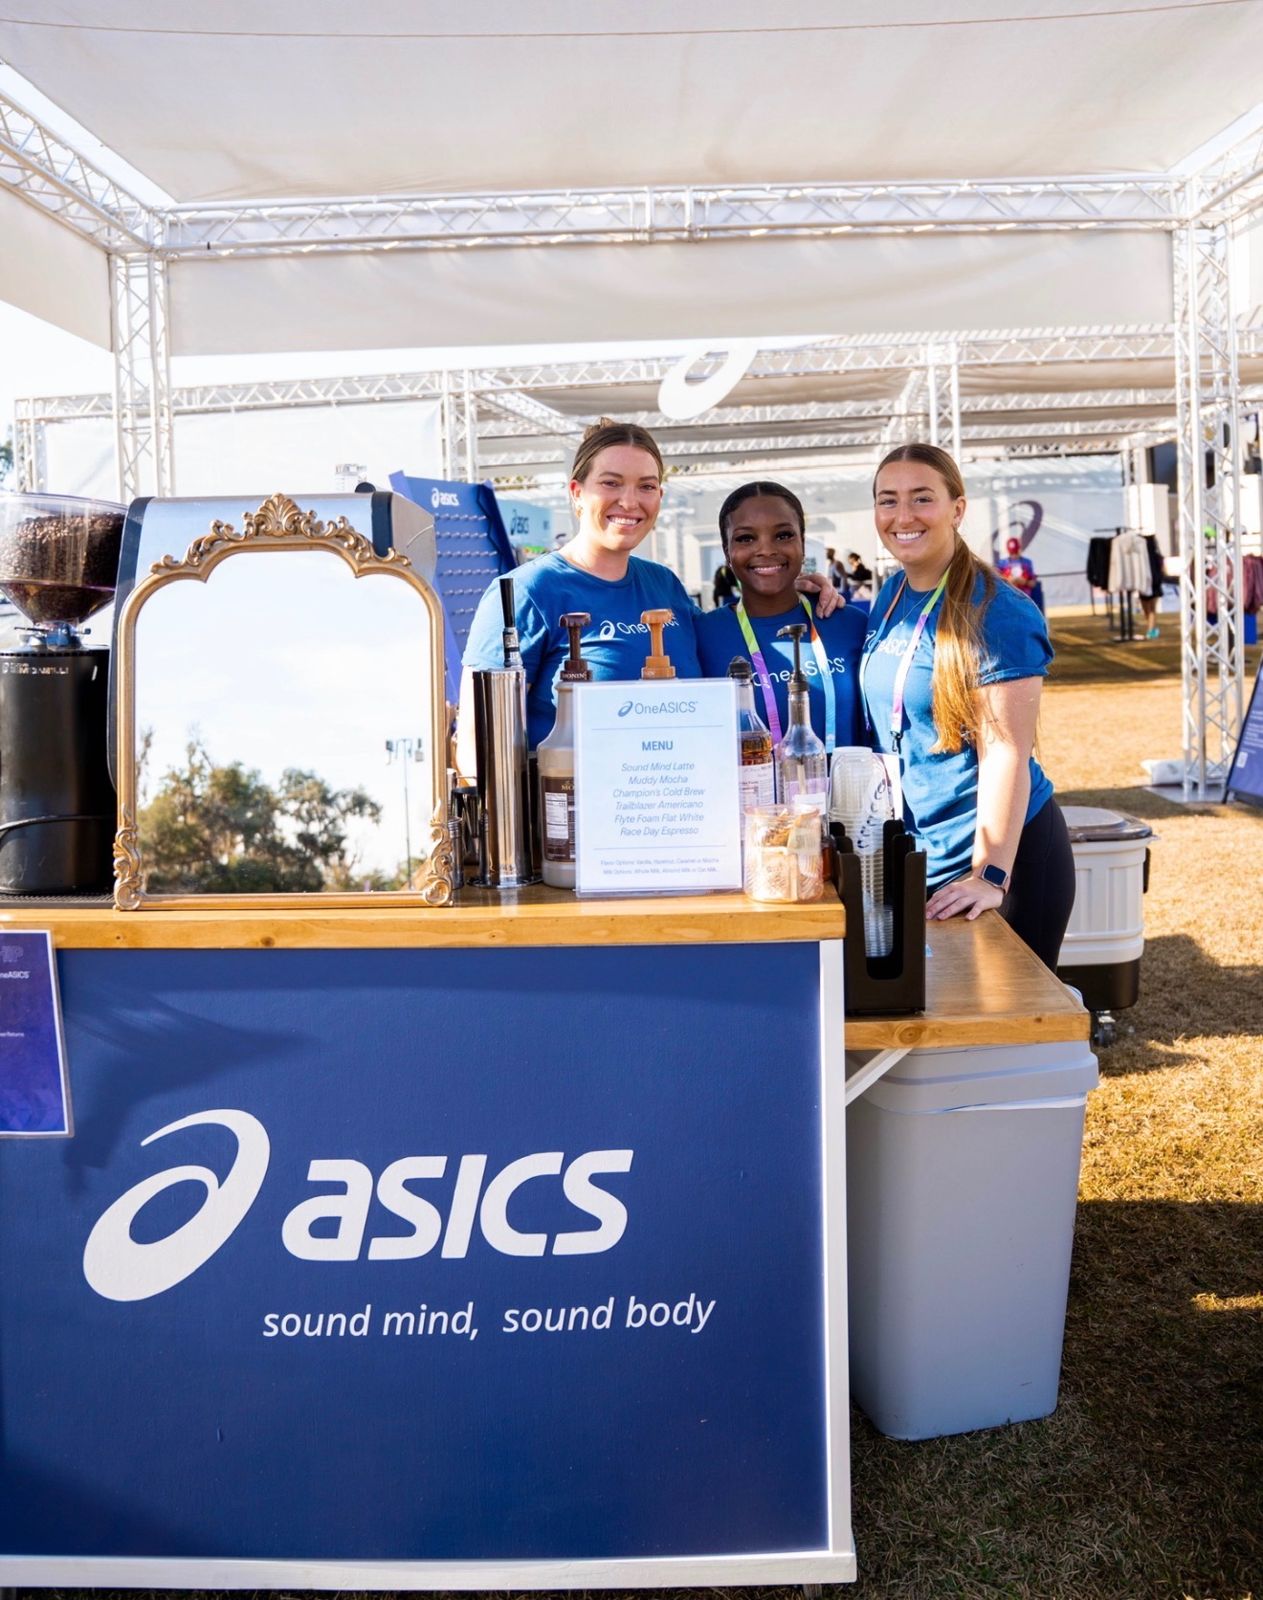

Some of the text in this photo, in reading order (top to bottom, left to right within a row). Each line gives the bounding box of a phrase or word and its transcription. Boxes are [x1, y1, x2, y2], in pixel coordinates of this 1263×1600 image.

[641, 740, 674, 751] MENU
[621, 761, 695, 772] Sound Mind Latte
[628, 775, 688, 785] Muddy Mocha
[663, 787, 684, 797] Cold
[684, 786, 705, 796] Brew
[616, 800, 704, 810] Trailblazer Americano
[615, 812, 705, 825] Flyte Foam Flat White
[621, 825, 699, 837] Race Day Espresso
[282, 1149, 633, 1261] asics
[262, 1292, 716, 1341] sound mind, sound body
